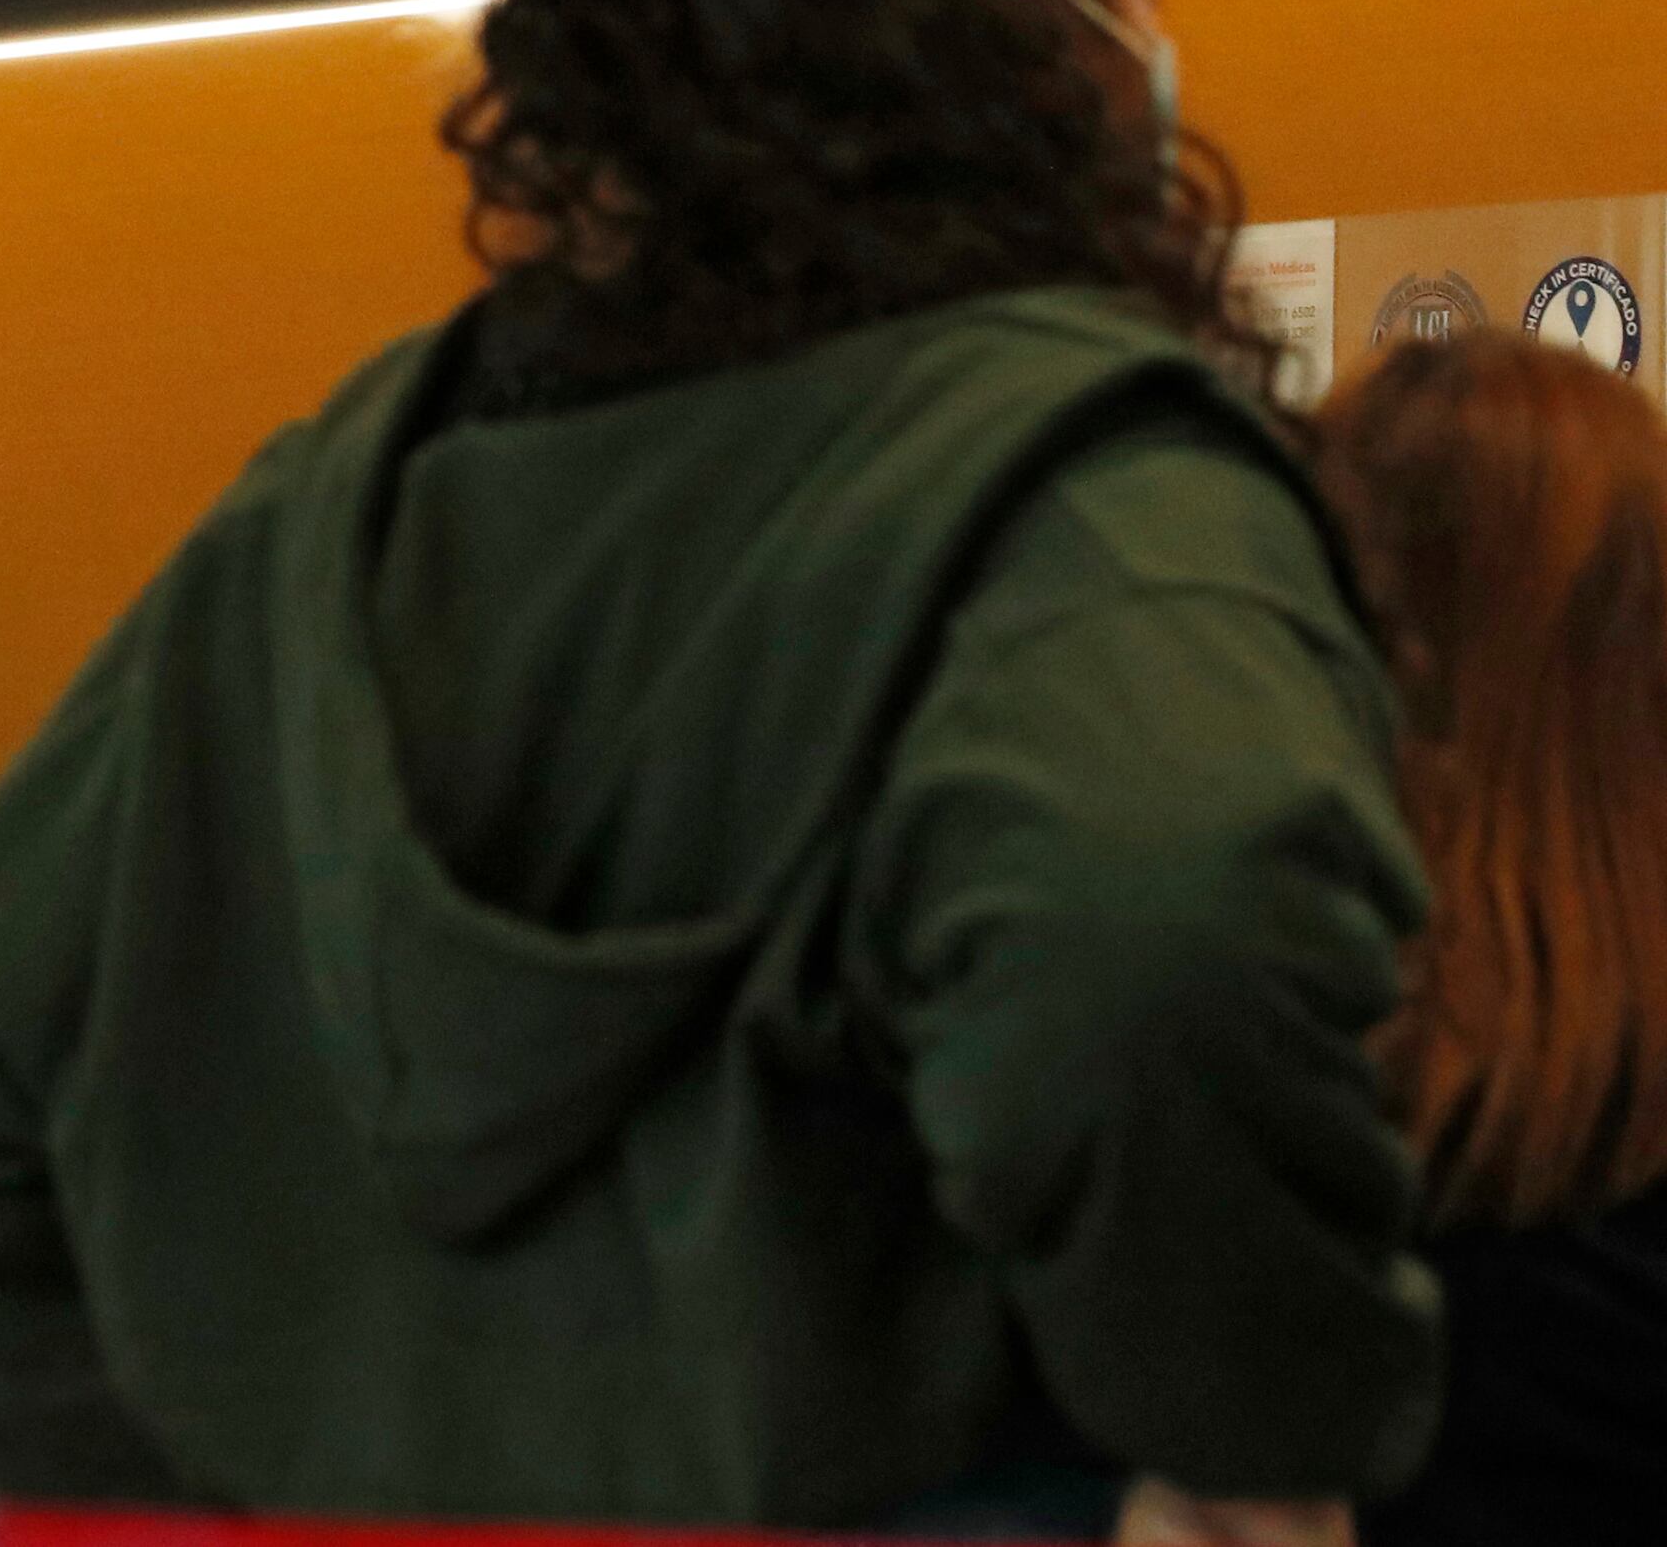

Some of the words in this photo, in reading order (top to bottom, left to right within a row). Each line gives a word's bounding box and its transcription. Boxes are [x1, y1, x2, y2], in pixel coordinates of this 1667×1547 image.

[1526, 284, 1553, 331] HECK
[1551, 269, 1567, 288] IN
[1568, 262, 1638, 336] CERTIFICADO
